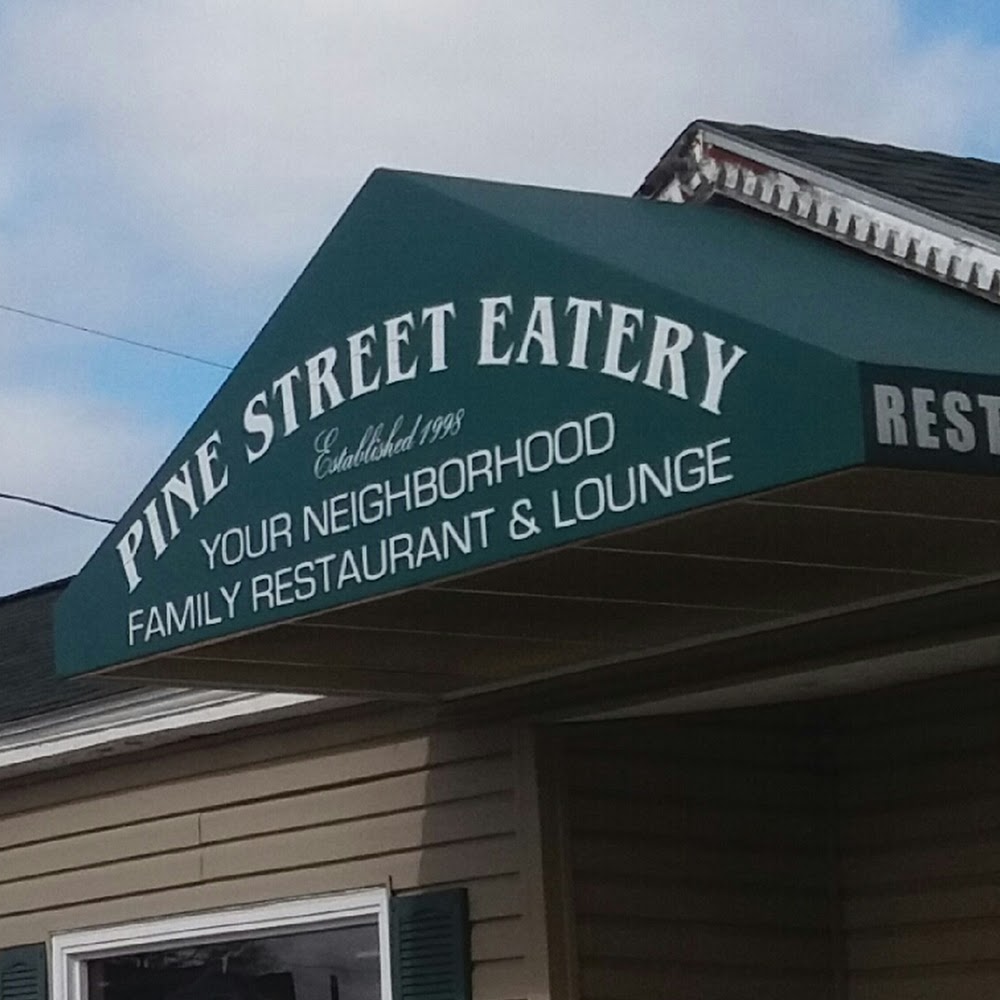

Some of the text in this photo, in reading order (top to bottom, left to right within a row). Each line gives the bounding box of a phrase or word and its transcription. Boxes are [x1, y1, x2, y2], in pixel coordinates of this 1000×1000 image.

[115, 295, 747, 594] PINE STREET EATERY
[200, 411, 615, 570] YOUR NEIGHBORHOOD
[314, 408, 465, 480] Established 1998
[873, 383, 1000, 456] REST
[128, 437, 734, 646] FAMILY RESTAURANT & LOUNGE
